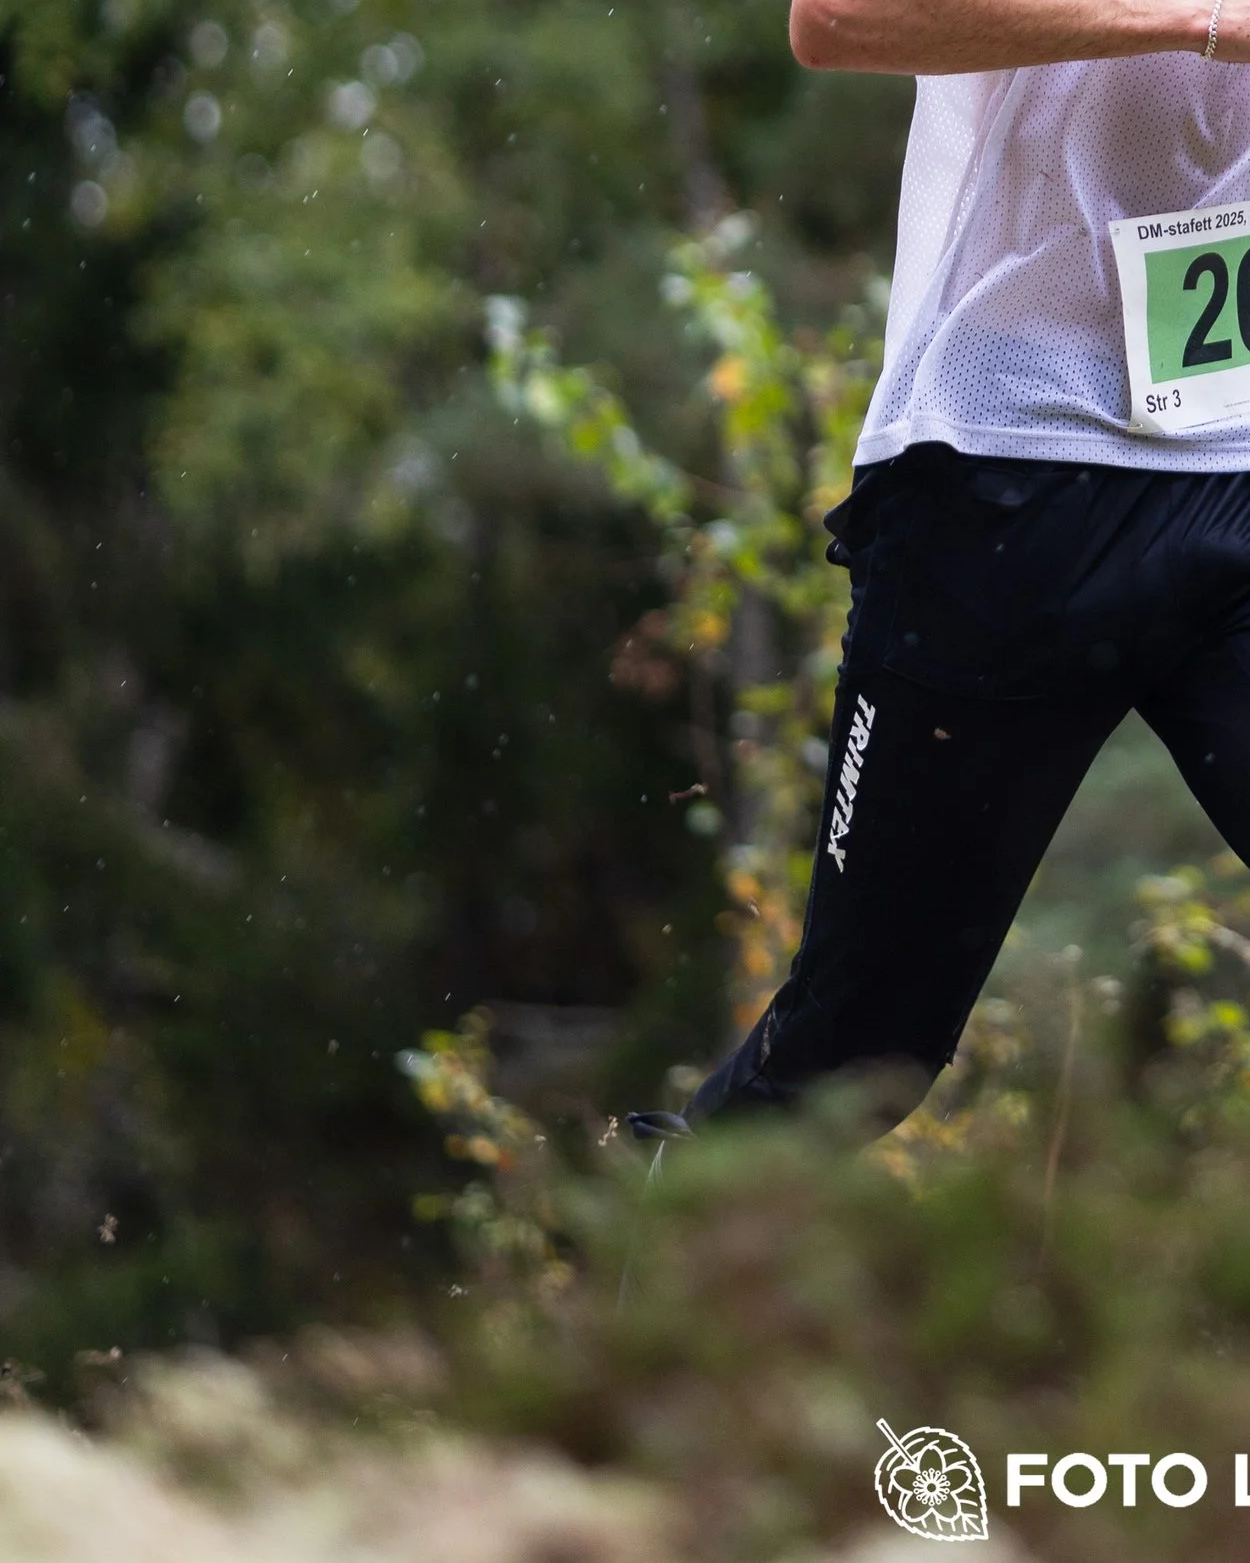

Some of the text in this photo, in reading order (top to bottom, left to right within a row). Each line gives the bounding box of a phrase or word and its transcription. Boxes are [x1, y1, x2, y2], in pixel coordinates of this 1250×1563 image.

[1137, 217, 1212, 240] DM-stafett
[1215, 210, 1247, 229] 2025,
[1146, 389, 1182, 414] Str 3
[827, 693, 876, 874] TRIMTEX
